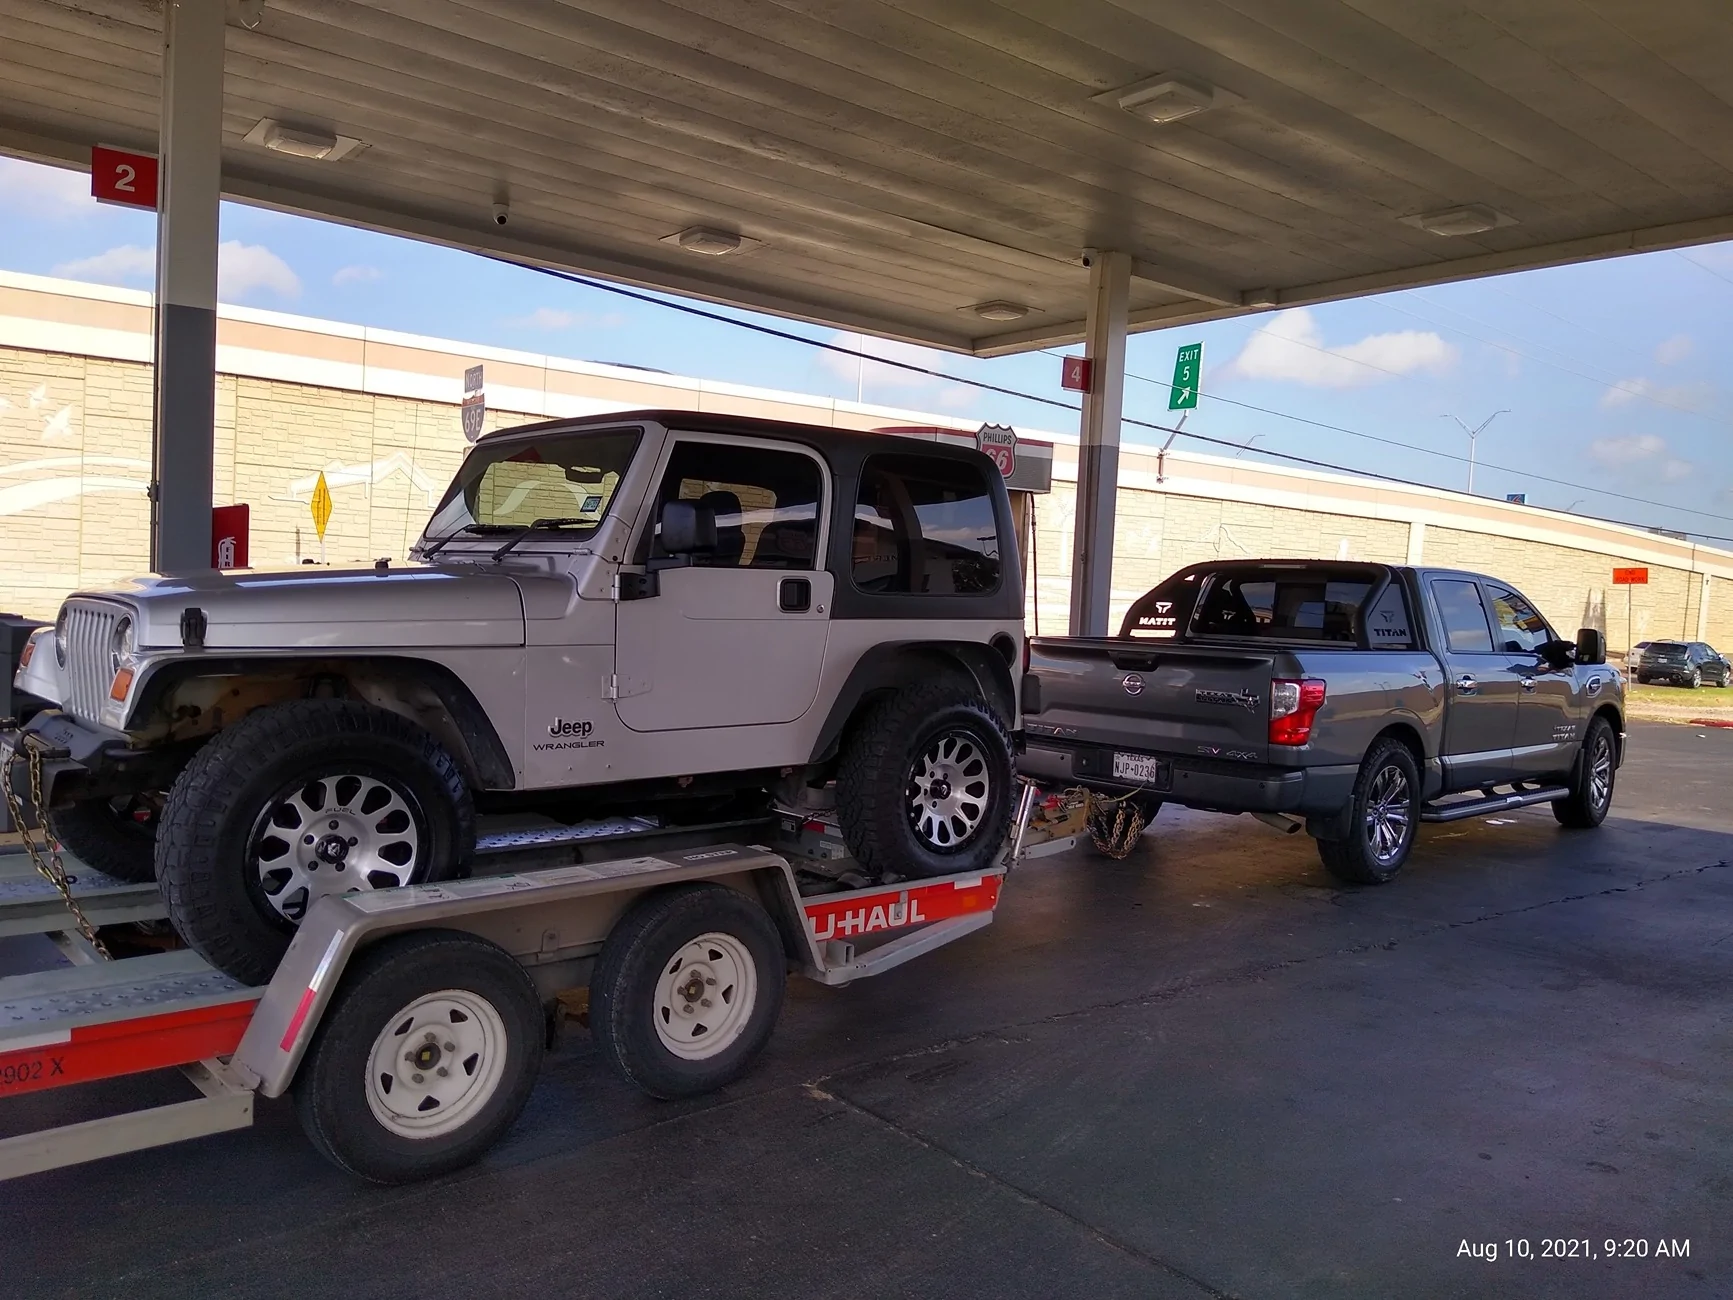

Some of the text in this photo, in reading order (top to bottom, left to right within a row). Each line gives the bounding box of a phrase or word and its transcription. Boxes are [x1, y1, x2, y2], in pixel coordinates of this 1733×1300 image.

[115, 164, 136, 192] 2
[1179, 349, 1199, 362] EXIT
[465, 371, 483, 389] NORTH
[1071, 366, 1081, 382] 4
[1182, 366, 1190, 381] 5
[464, 408, 481, 433] 69E
[983, 432, 1012, 445] PHILLIPS
[1373, 628, 1407, 637] TITAN
[549, 718, 593, 738] Jeep
[533, 740, 605, 751] WRANGLER
[1197, 745, 1221, 755] SV
[1127, 755, 1144, 763] TEXAS
[325, 807, 356, 816] FUEL
[808, 899, 926, 940] U-HAUL
[0, 1056, 65, 1085] 902 X
